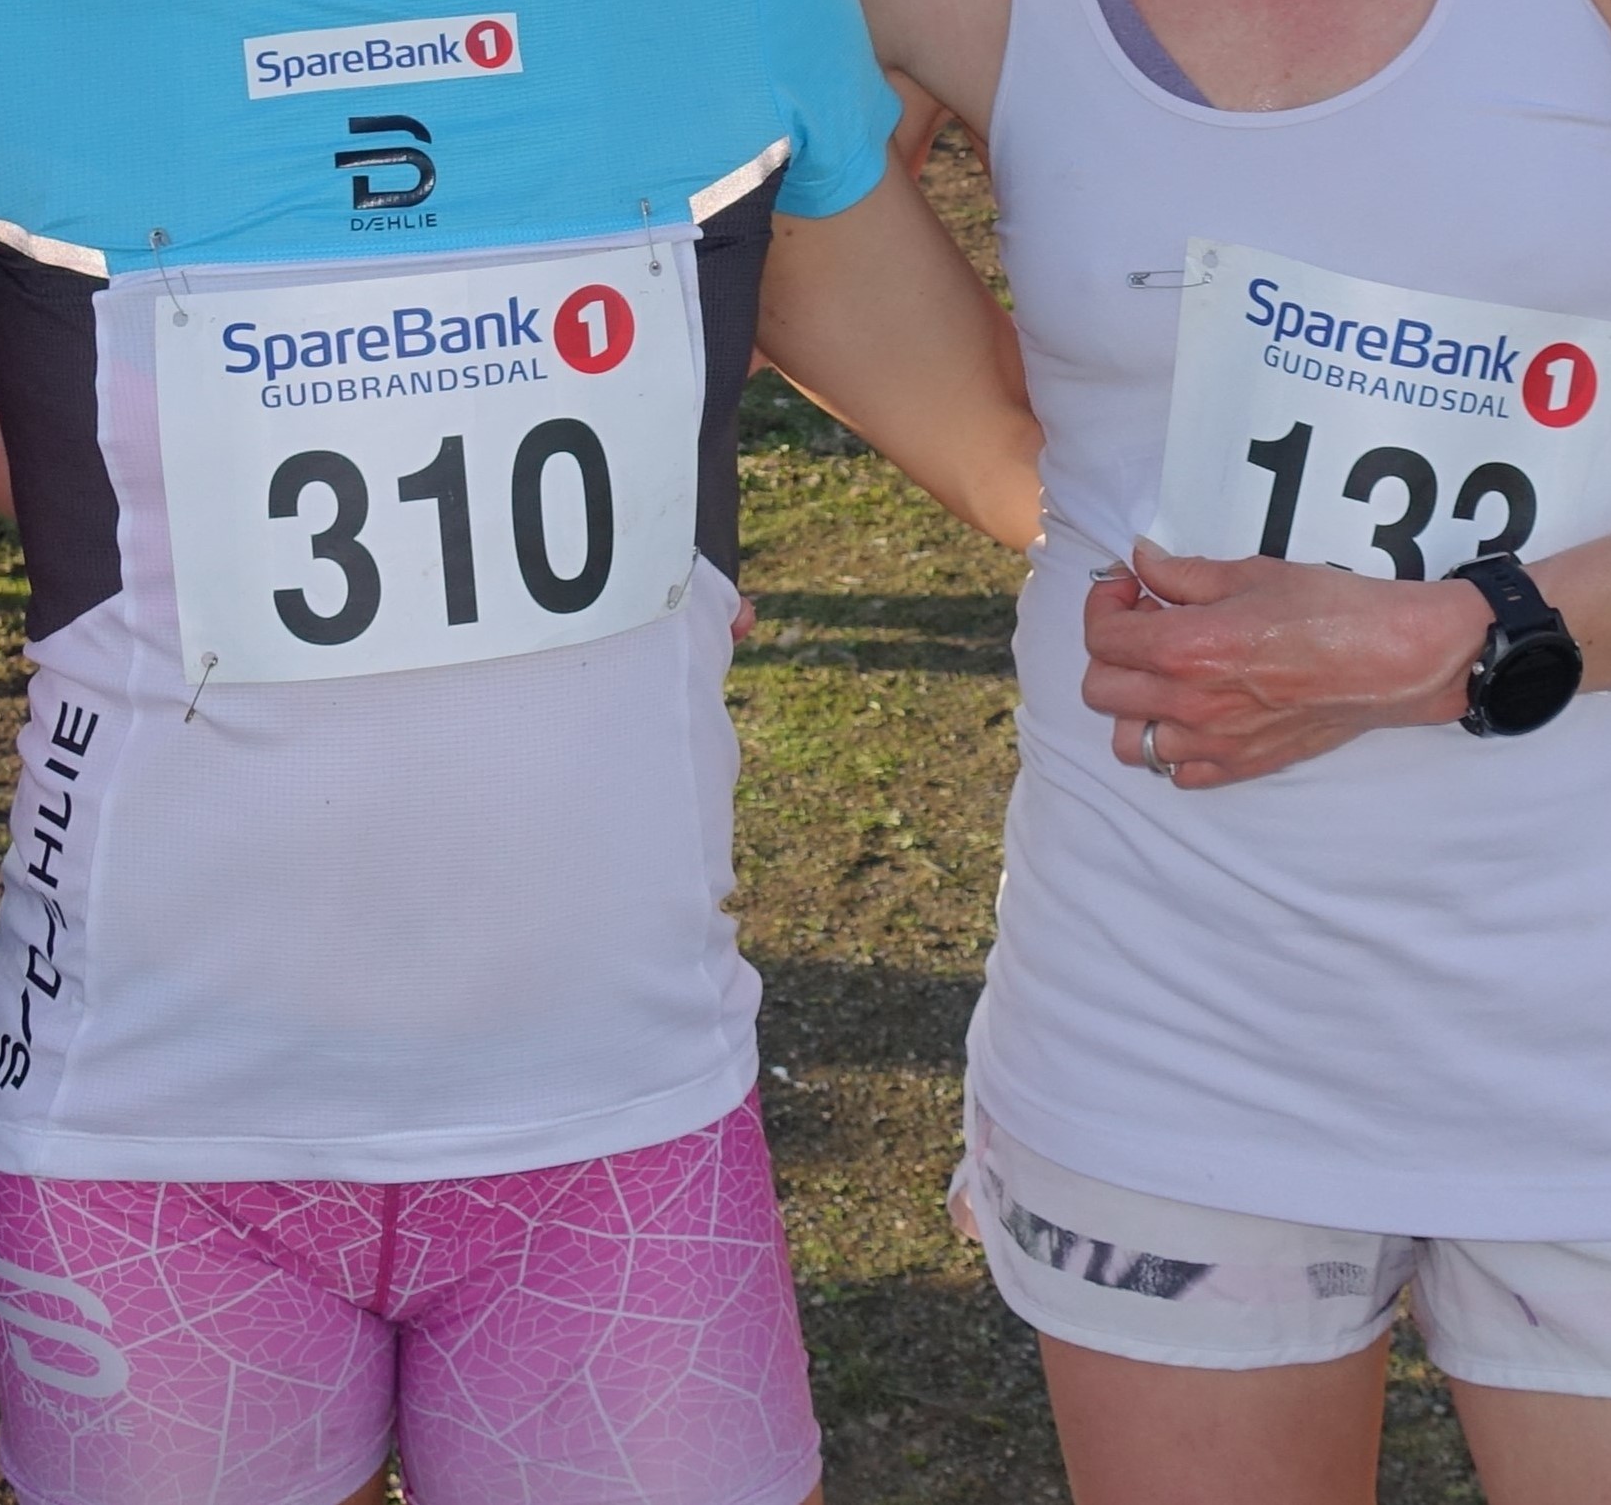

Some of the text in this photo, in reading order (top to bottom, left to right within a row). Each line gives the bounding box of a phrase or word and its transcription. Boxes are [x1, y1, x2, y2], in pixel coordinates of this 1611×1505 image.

[256, 33, 463, 88] SpareBank
[222, 296, 544, 380] SpareBank
[1245, 277, 1521, 385] SpareBank
[261, 357, 549, 409] GUDBRANDSDAL
[1263, 344, 1510, 420] GUDBRANDSDAL
[268, 417, 614, 646] 310
